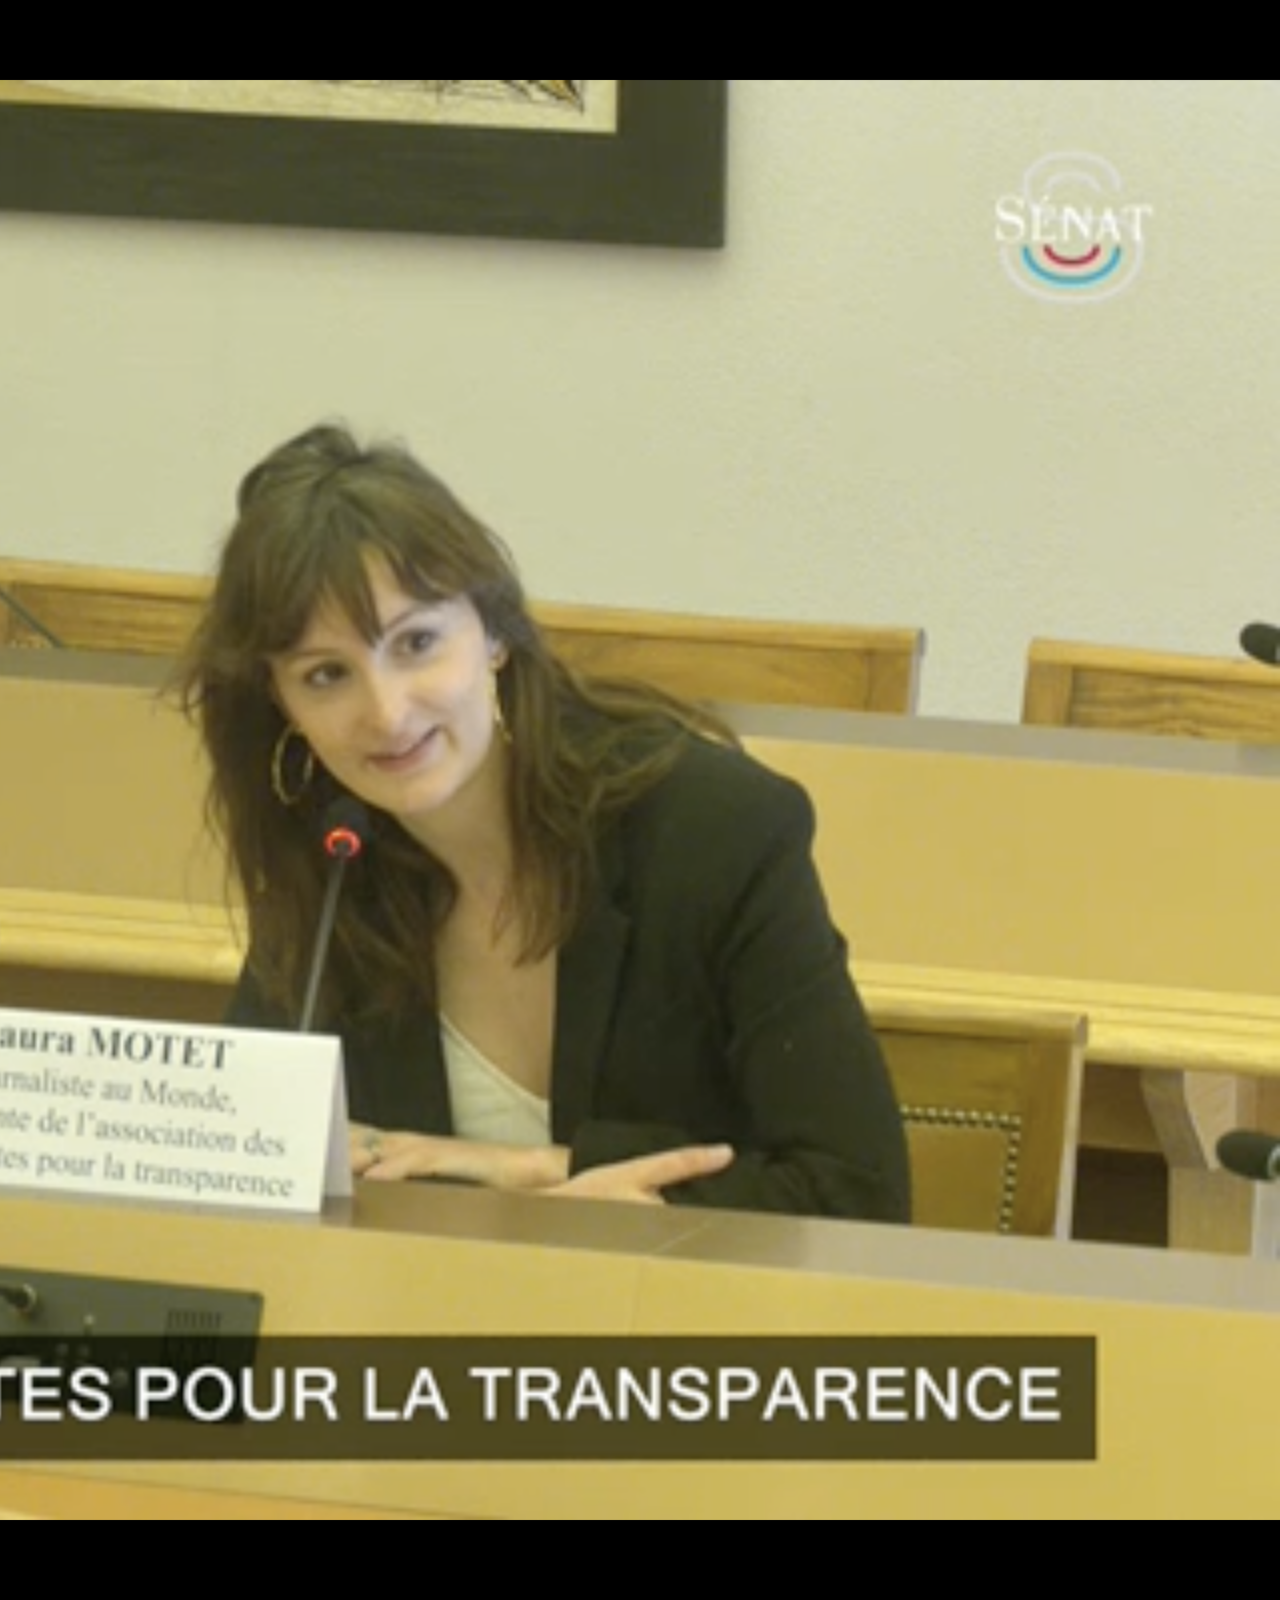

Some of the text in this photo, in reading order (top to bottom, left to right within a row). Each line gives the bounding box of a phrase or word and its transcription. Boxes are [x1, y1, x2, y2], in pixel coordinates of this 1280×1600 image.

[85, 1026, 235, 1070] MOTET
[100, 1079, 132, 1102] au
[138, 1079, 237, 1115] Monde,
[38, 1108, 69, 1135] de
[244, 1129, 286, 1157] des
[36, 1149, 97, 1177] pour
[103, 1152, 125, 1181] la
[133, 1161, 295, 1198] transparence
